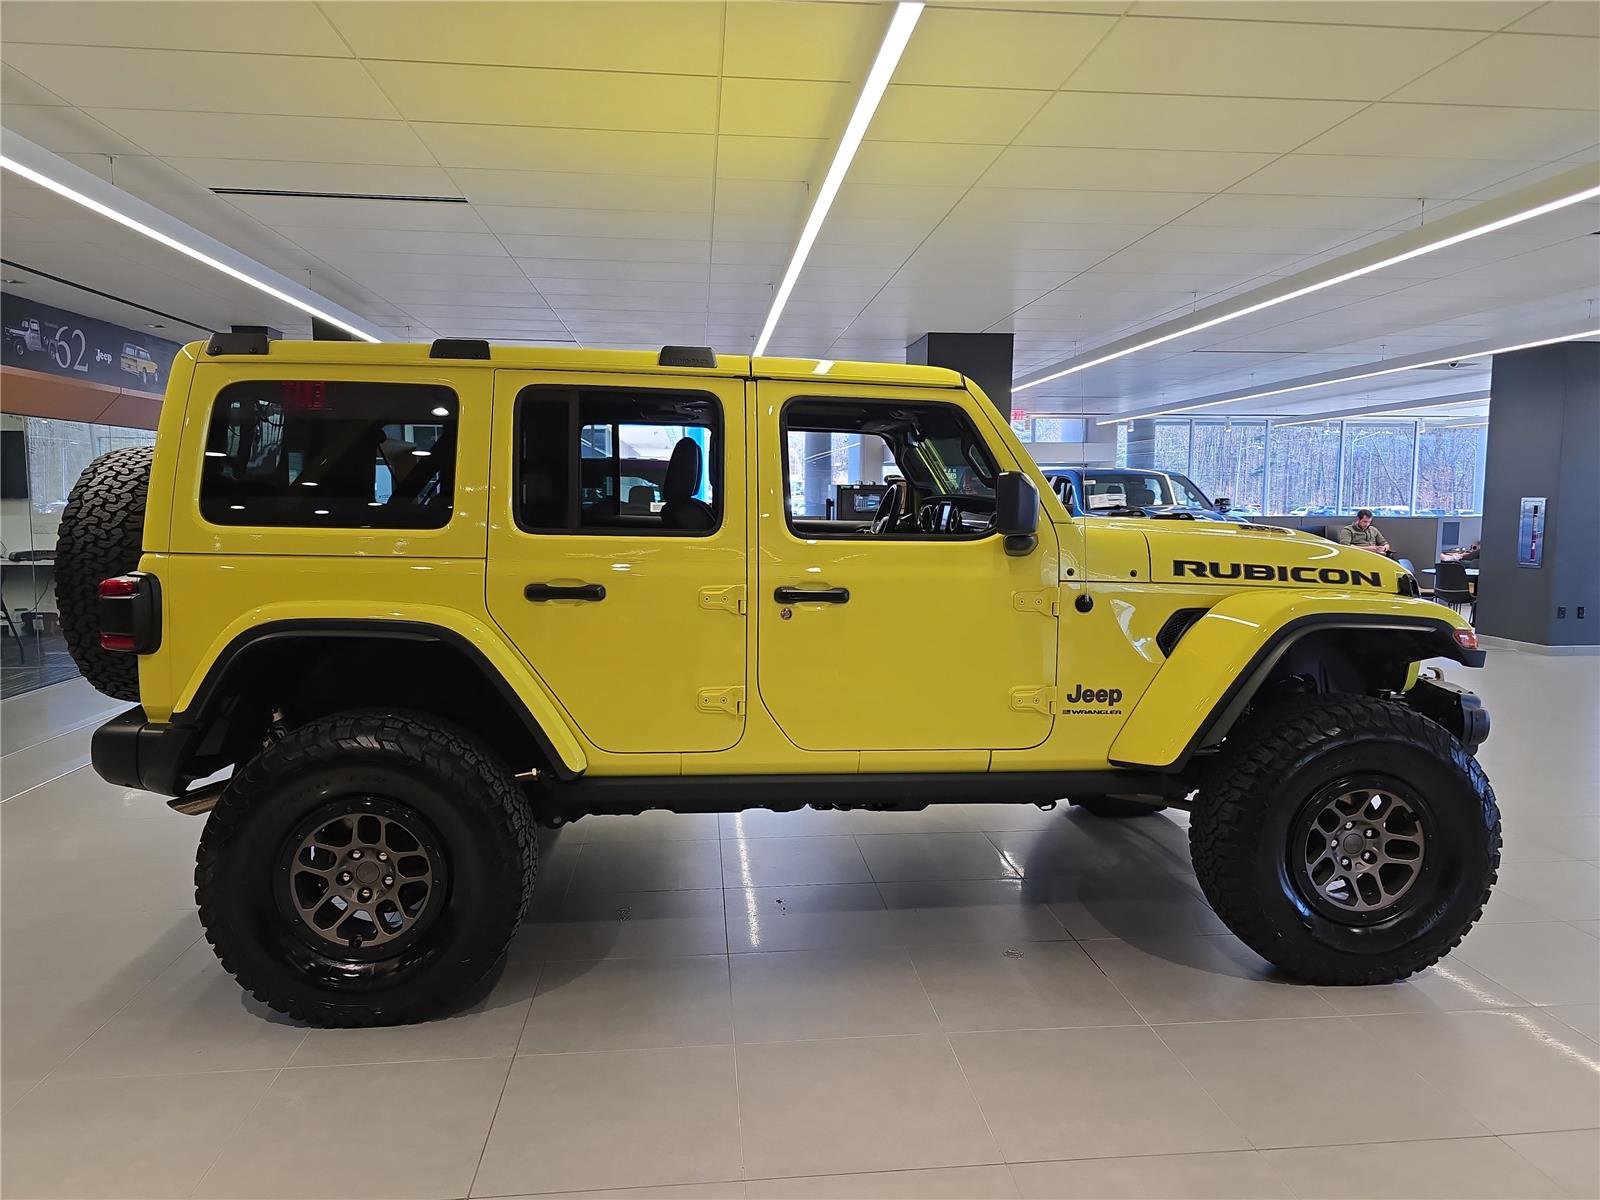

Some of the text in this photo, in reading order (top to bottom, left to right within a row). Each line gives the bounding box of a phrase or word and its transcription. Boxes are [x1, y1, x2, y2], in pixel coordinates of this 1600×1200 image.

[55, 325, 89, 372] 62
[95, 349, 113, 364] Jeep
[1172, 559, 1382, 588] RUBICON
[1066, 684, 1123, 706] Jeep
